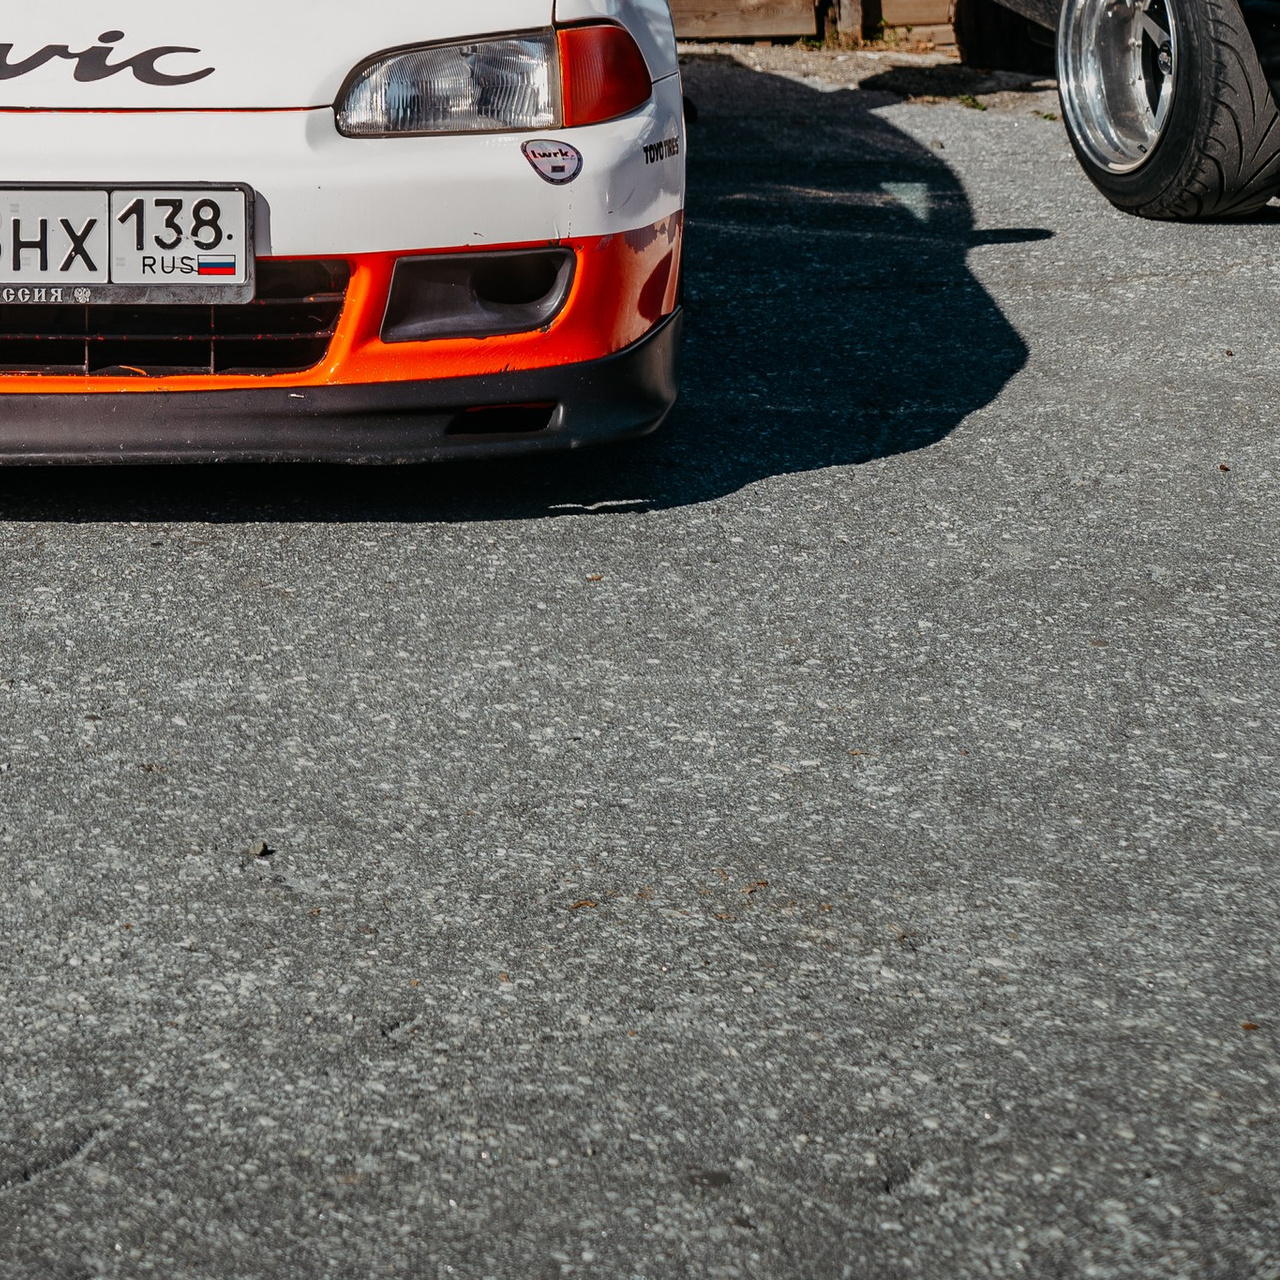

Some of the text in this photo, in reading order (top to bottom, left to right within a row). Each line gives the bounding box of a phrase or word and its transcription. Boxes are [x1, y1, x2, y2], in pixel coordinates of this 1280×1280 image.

[643, 140, 663, 165] TOYO
[117, 198, 222, 251] 138
[141, 255, 196, 275] RUS
